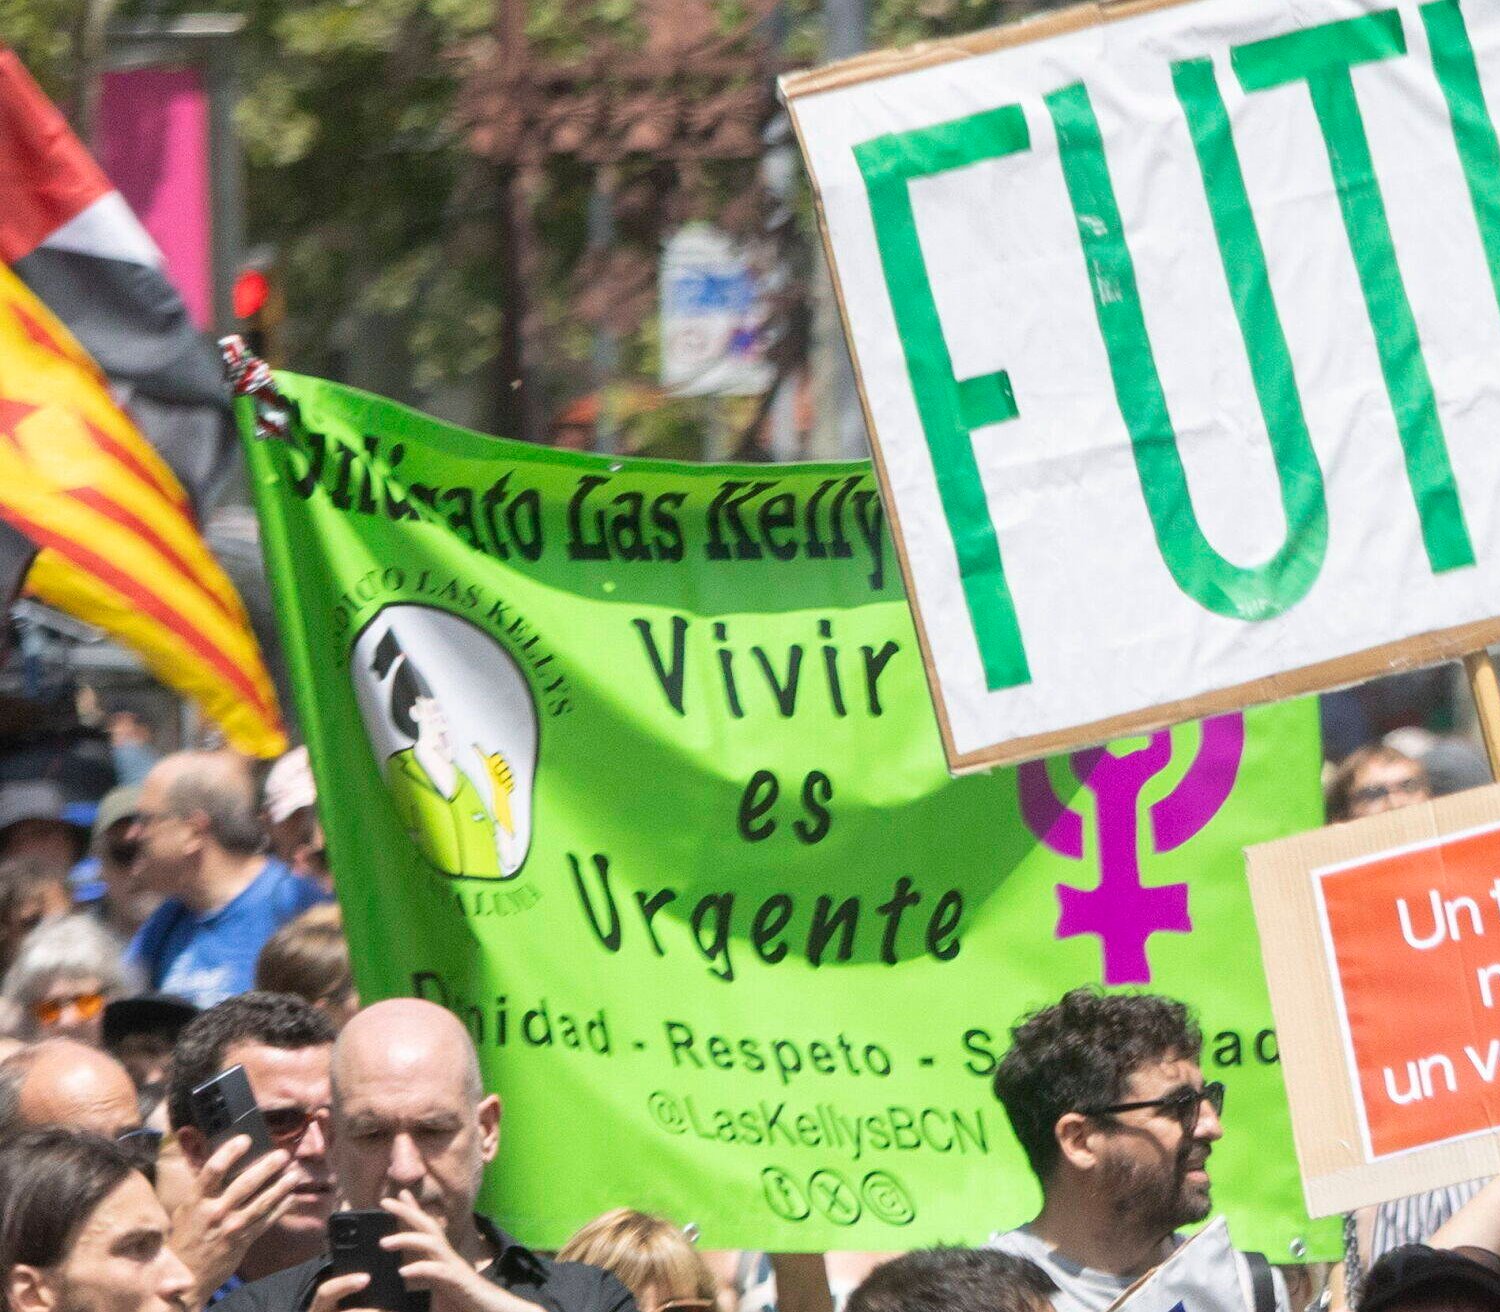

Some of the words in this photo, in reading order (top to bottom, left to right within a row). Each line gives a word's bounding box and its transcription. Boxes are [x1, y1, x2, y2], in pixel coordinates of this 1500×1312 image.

[567, 474, 689, 562] Las
[632, 615, 900, 719] Vivir
[738, 770, 833, 844] es
[566, 852, 965, 982] Urgente
[1396, 889, 1484, 951] Un
[664, 1020, 891, 1085] Respeto
[1384, 1052, 1457, 1106] un
[649, 1090, 989, 1161] @LasKellysBCN
